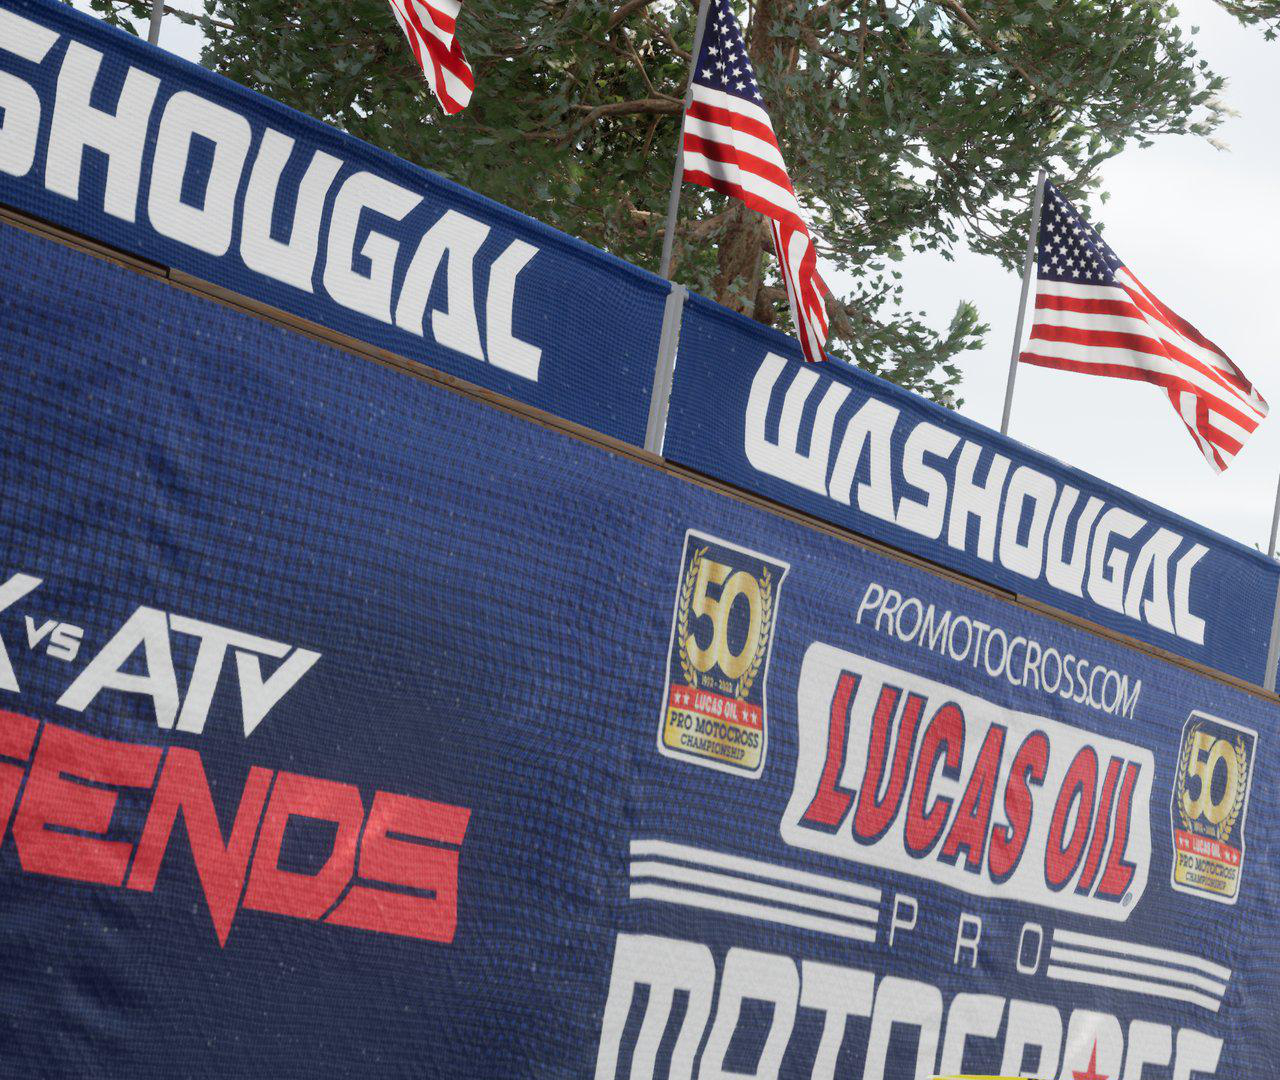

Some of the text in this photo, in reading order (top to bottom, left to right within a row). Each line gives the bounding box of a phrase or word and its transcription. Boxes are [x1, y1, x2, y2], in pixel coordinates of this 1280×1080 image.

[744, 351, 1210, 645] WASHOUGAL
[684, 558, 760, 679] 50
[856, 583, 1142, 720] PROMOTOCROSS.COM
[56, 604, 323, 738] ATV
[694, 692, 739, 721] LUCAS OIL
[669, 710, 759, 749] PRO MOTOCROSS
[680, 733, 746, 761] CHAMPIONSHIP
[1182, 737, 1238, 821] 50
[797, 669, 1142, 905] LUCAS OIL
[889, 892, 1047, 977] PRO
